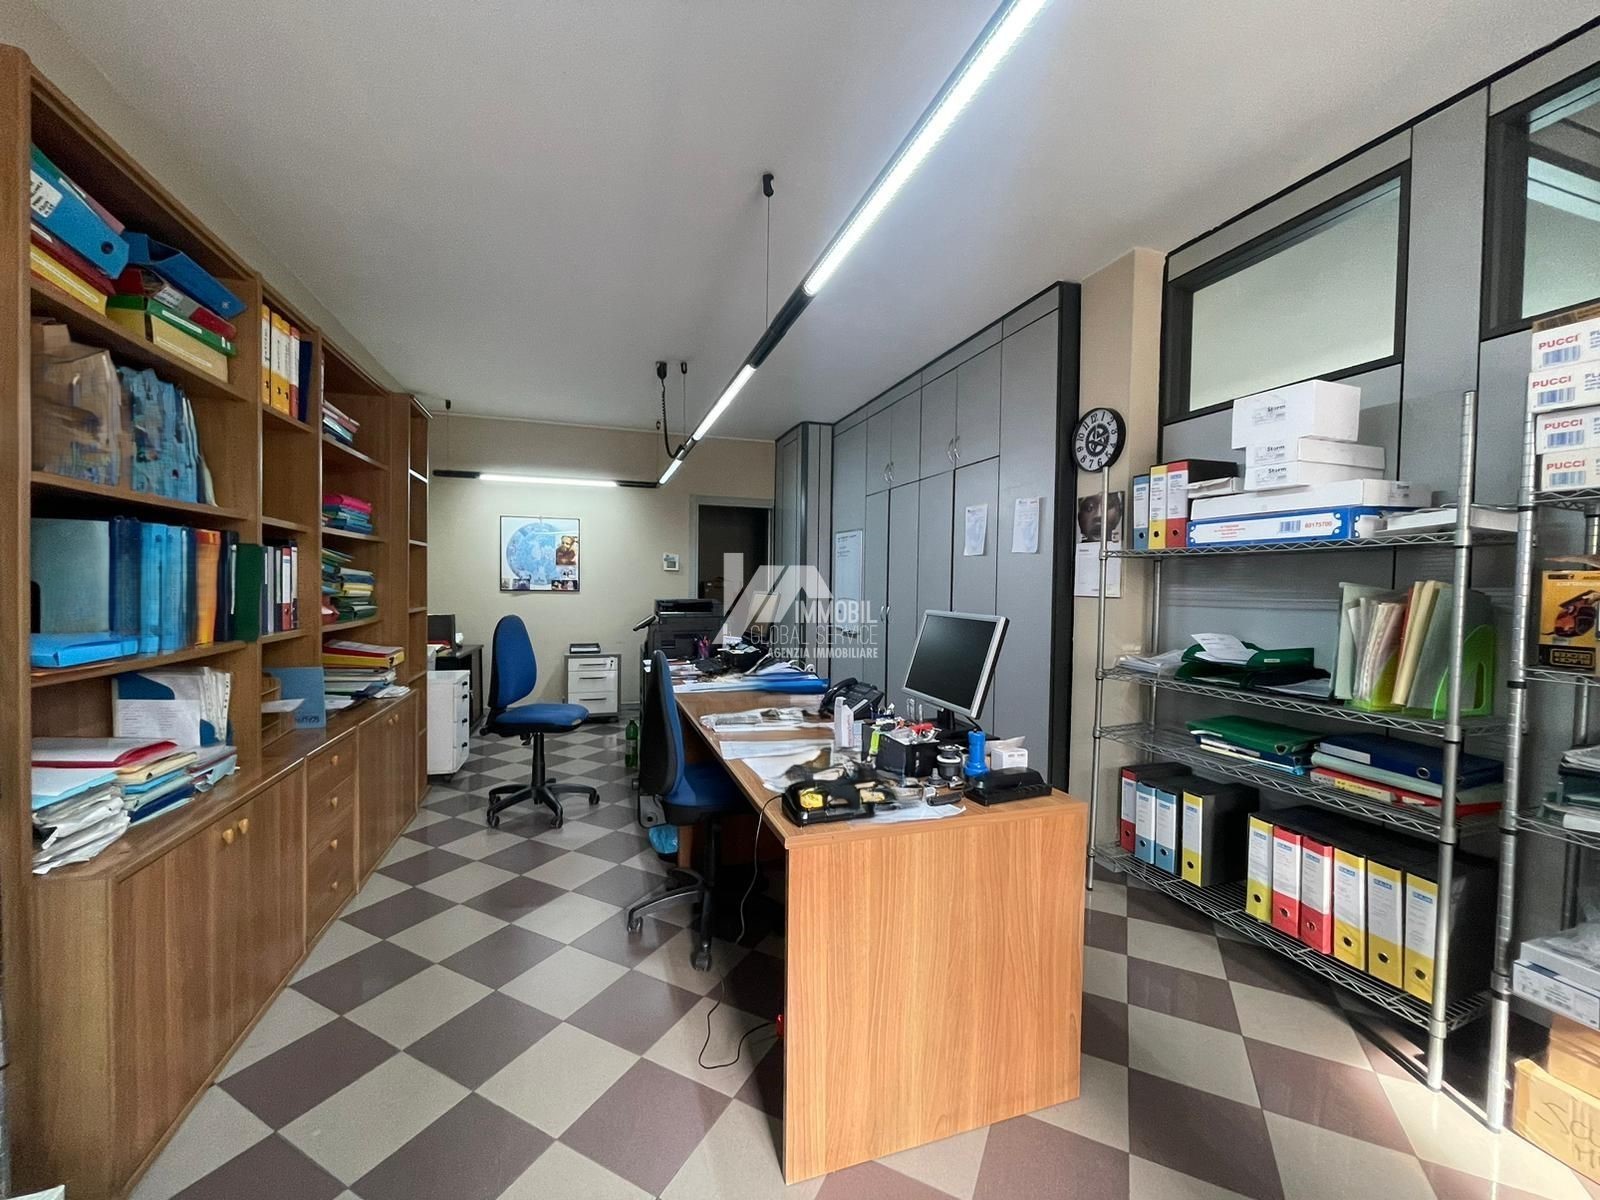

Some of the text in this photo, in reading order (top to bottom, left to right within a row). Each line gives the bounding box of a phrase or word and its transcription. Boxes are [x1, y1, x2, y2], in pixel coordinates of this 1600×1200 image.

[1538, 334, 1579, 350] PUCCI
[1532, 375, 1572, 389] PUCCI
[1543, 418, 1584, 430] PUCCI
[1546, 459, 1586, 471] PUCCI
